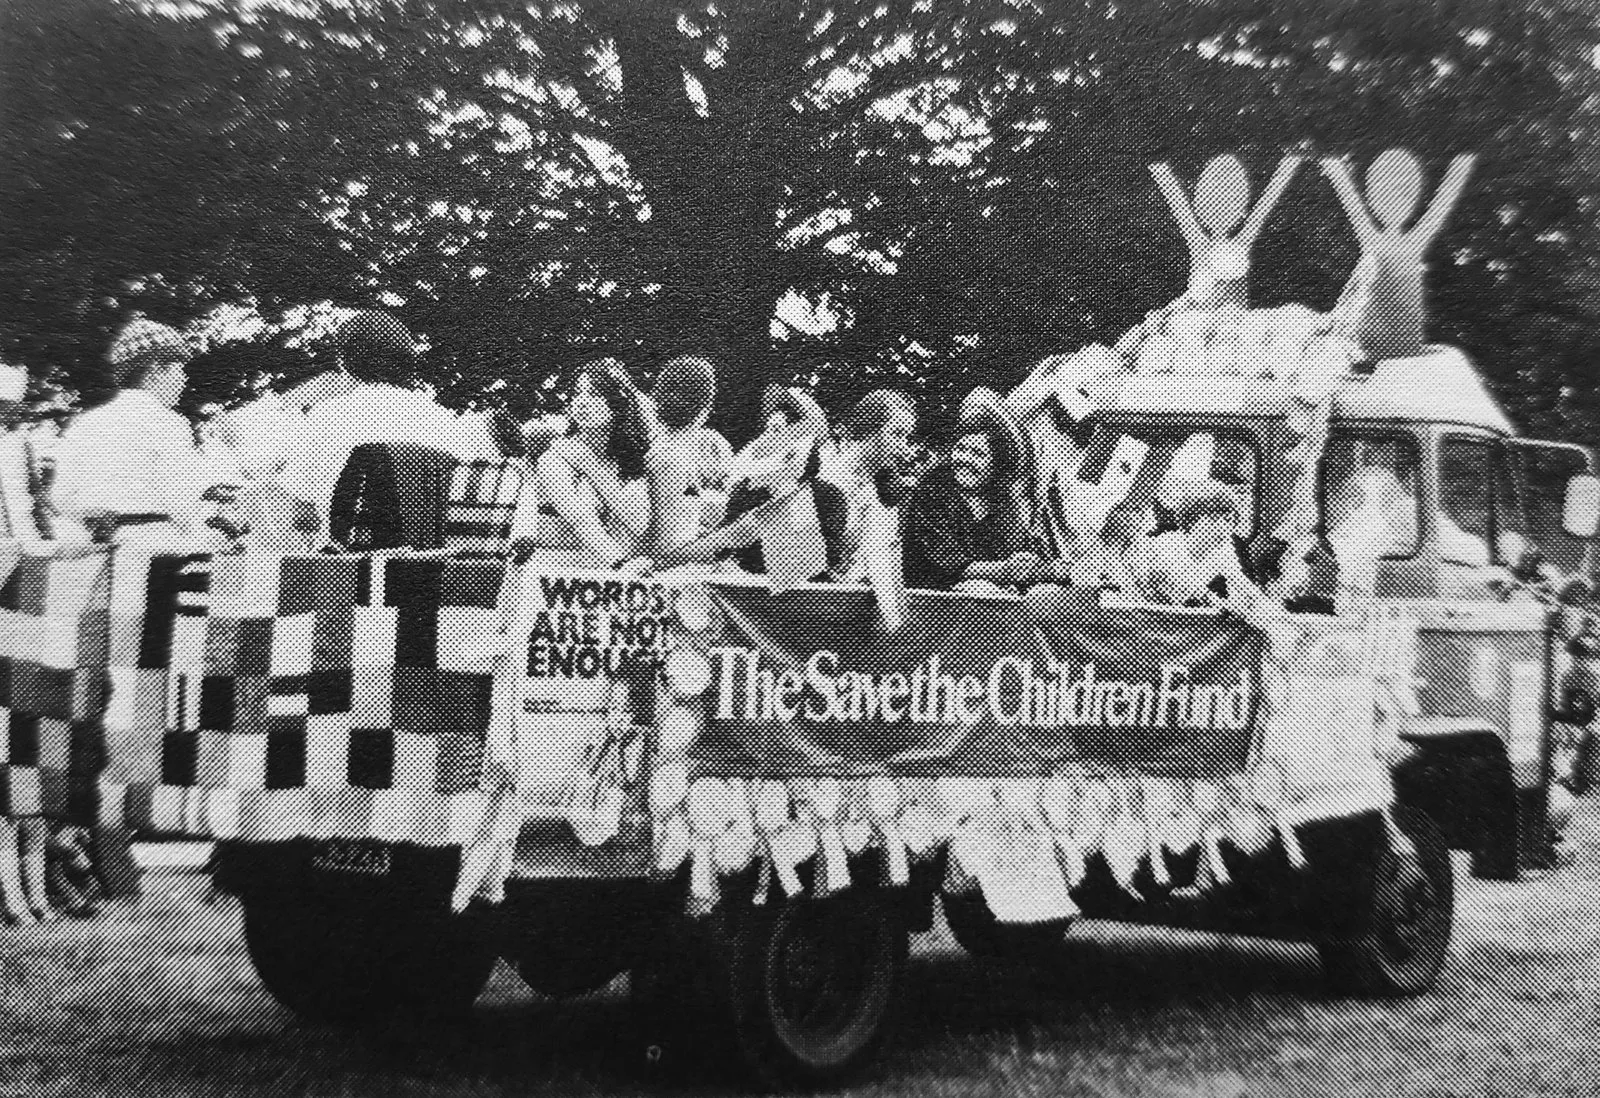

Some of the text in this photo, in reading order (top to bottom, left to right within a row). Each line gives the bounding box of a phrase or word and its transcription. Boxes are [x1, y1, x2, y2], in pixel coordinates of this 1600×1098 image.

[540, 576, 664, 613] WORDS
[528, 612, 599, 644] ARE
[526, 646, 668, 678] ENOU
[709, 647, 1248, 728] The Save the Children Fund
